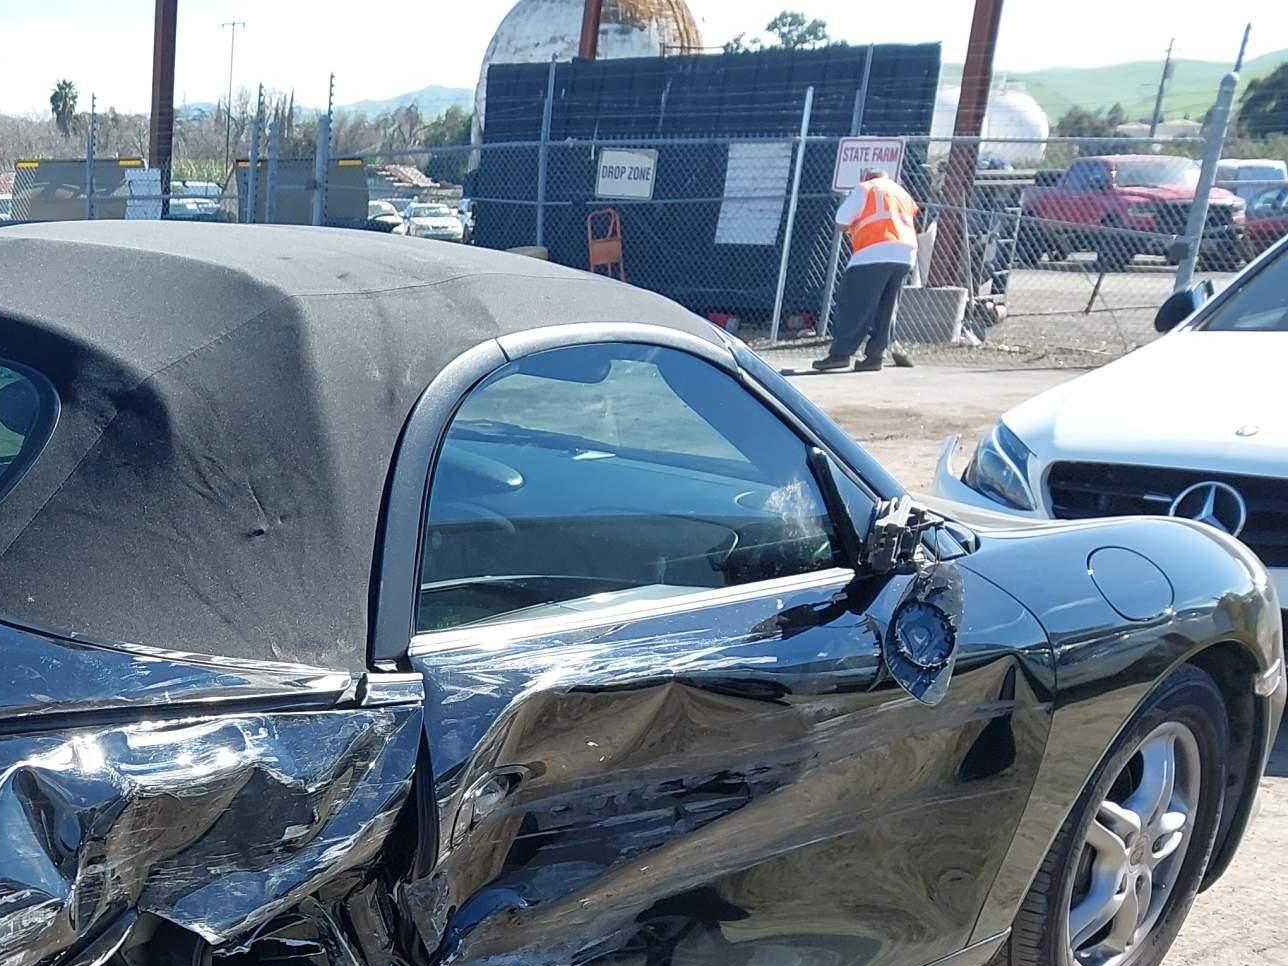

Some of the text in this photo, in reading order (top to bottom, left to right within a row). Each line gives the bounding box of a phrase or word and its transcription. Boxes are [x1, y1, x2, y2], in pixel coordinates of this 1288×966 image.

[842, 146, 899, 162] STATE FARM
[601, 165, 652, 181] DROP ZONE
